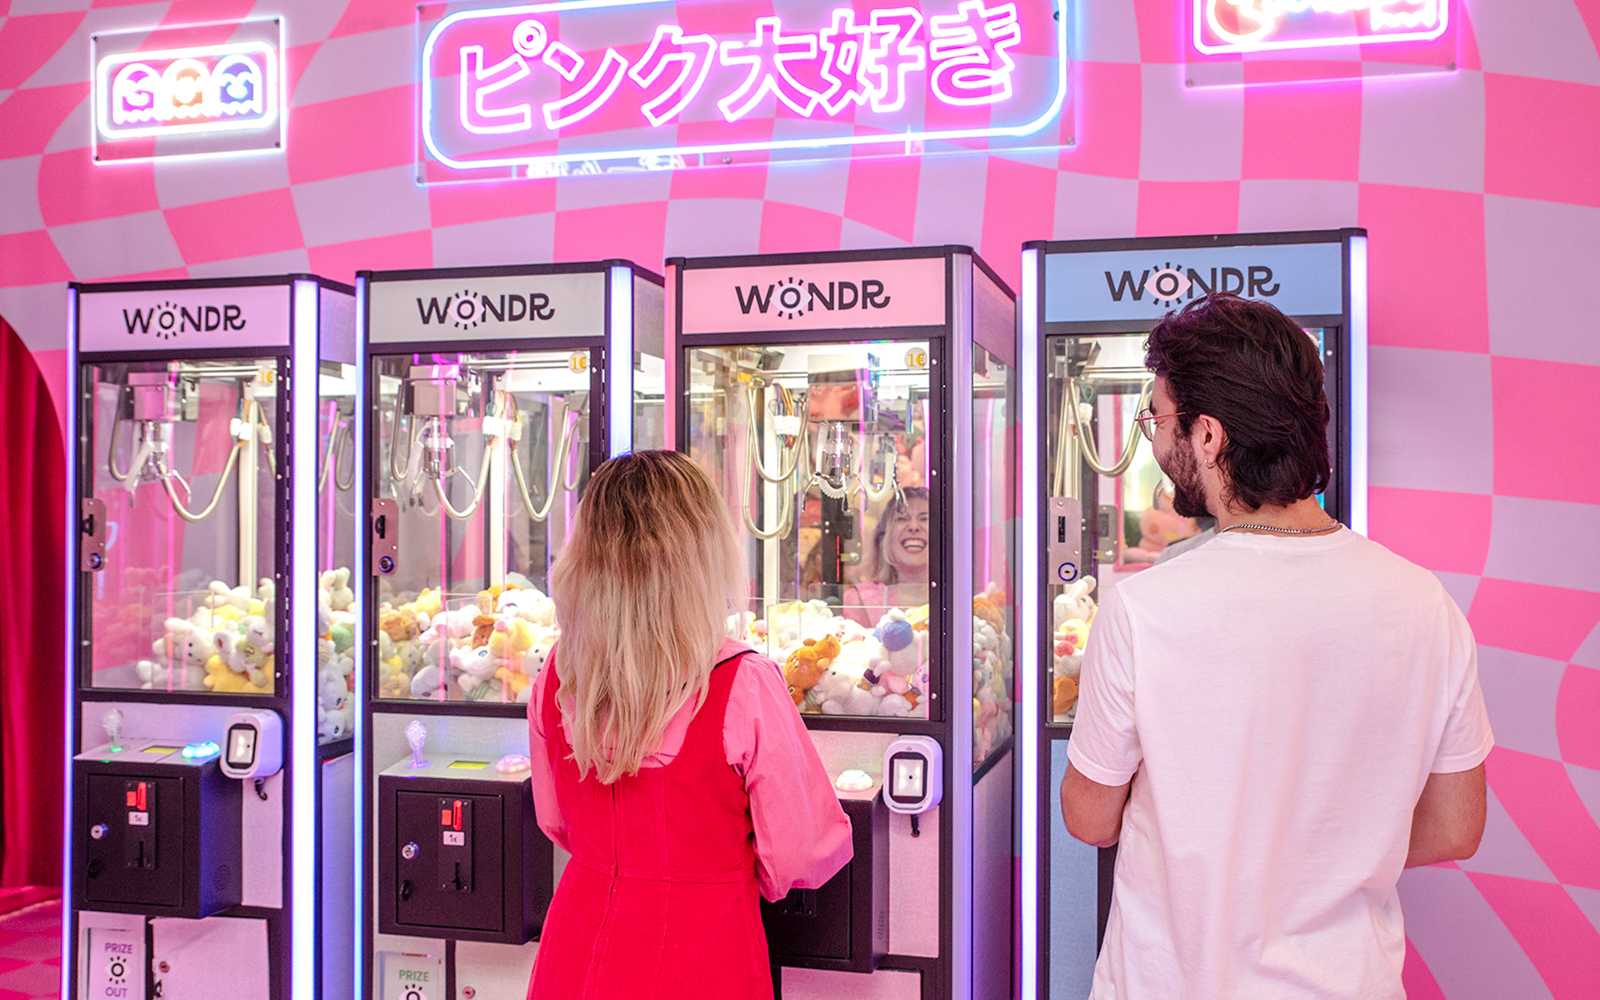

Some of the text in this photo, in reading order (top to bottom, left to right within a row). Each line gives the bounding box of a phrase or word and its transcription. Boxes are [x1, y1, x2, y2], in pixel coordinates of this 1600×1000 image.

[459, 1, 1022, 134] ピンク大好き
[1104, 263, 1280, 306] WONDR
[416, 290, 555, 329] WONDR
[735, 278, 891, 318] WONDR
[122, 303, 246, 338] WONDR
[572, 357, 587, 370] 1€
[908, 353, 925, 367] 1€
[105, 942, 133, 955] PRIZE
[399, 969, 430, 982] PRIZE
[105, 986, 128, 998] OUT
